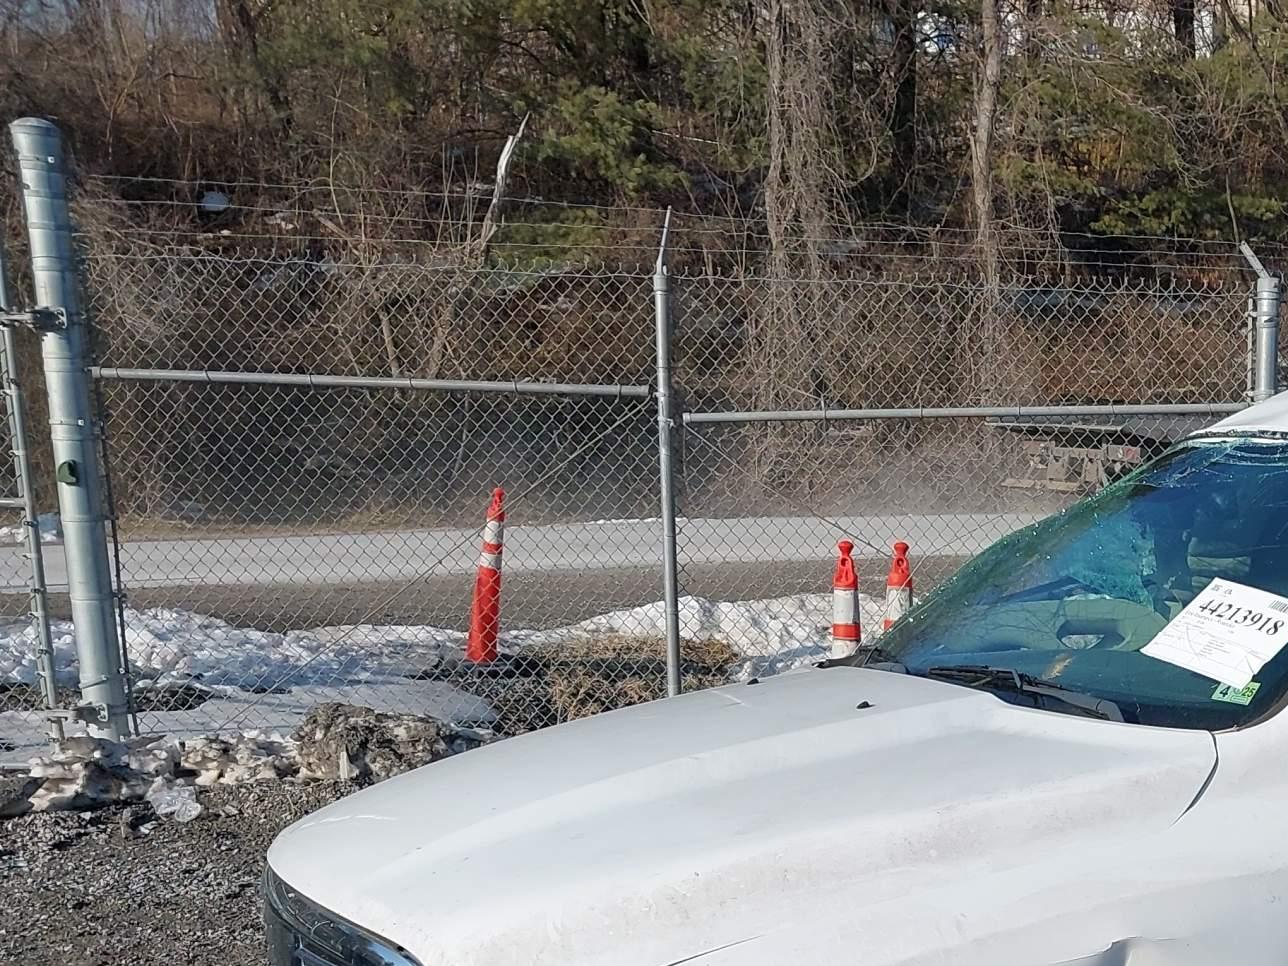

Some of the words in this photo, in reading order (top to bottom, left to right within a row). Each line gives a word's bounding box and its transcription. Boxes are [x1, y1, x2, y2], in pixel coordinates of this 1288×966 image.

[1199, 599, 1285, 636] 44213918
[1219, 684, 1231, 698] 4
[1241, 686, 1257, 698] 25
